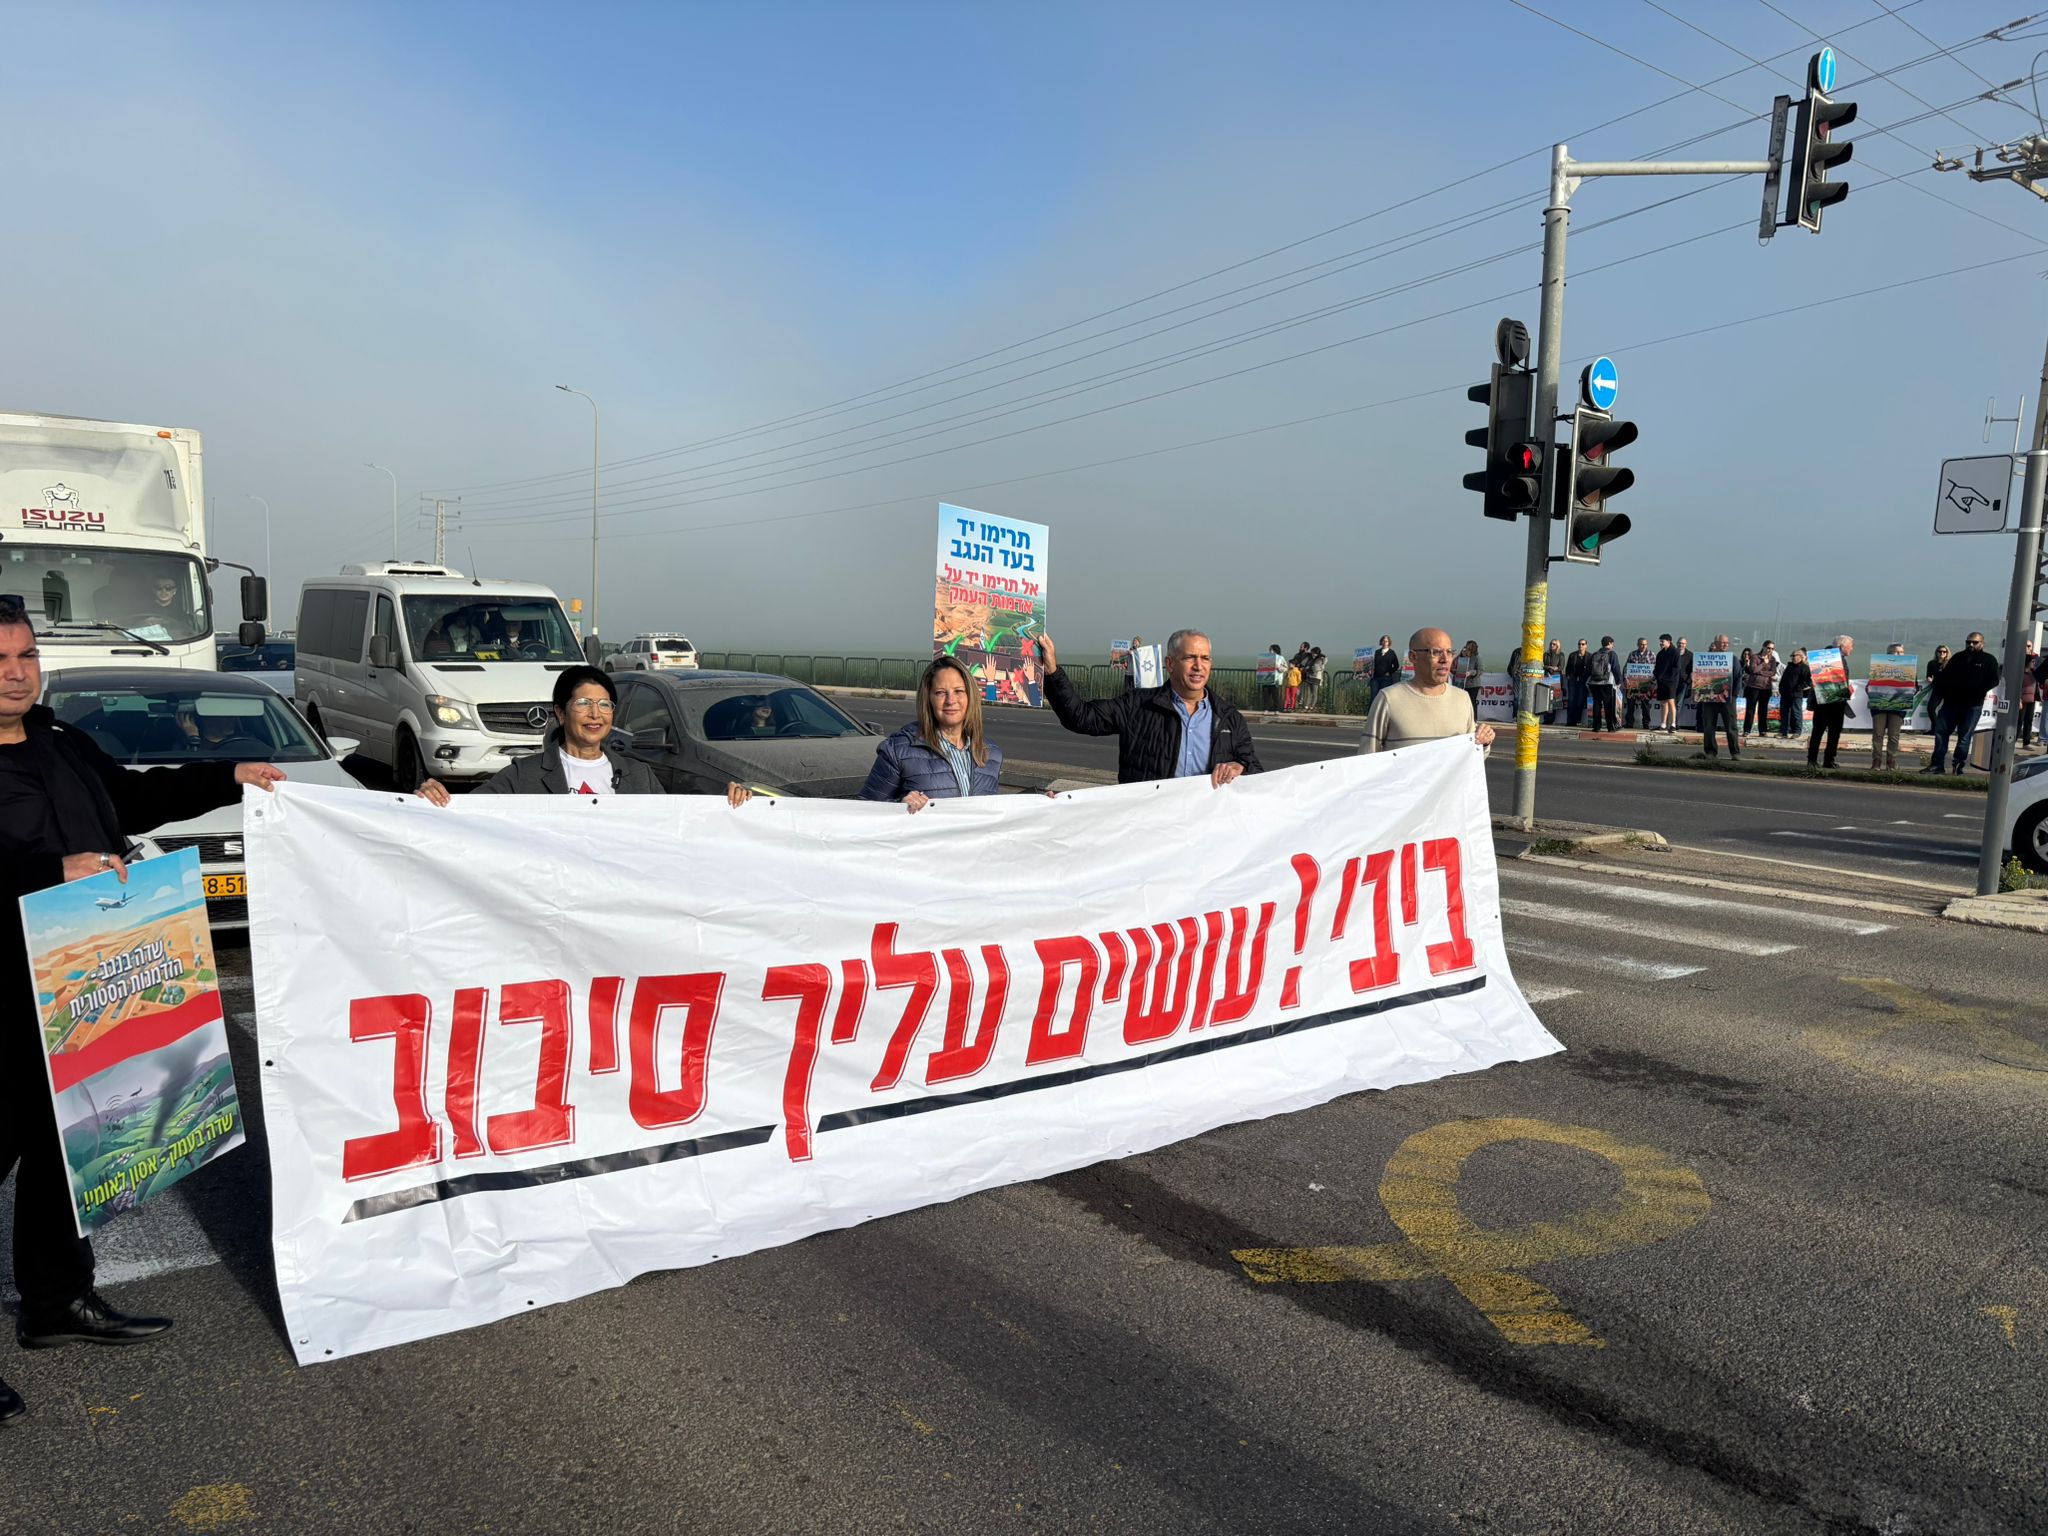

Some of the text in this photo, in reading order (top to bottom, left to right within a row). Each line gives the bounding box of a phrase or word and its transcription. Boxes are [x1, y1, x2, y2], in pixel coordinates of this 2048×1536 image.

[22, 508, 104, 523] ISUZU
[23, 520, 105, 532] SUMO
[957, 518, 1030, 549] תרימו יד
[950, 539, 1035, 572] בעד הנגב
[945, 563, 1039, 596] אל תרימו יד על
[949, 586, 1033, 613] אדמות העמק
[99, 953, 133, 980] בנגב
[134, 940, 164, 966] שדה
[69, 958, 185, 1019] הזדמנות הסטורית
[342, 837, 1477, 1183] ביבי! עושים עליך סיבוב
[205, 1113, 234, 1142] שדה
[168, 1129, 206, 1168] בעמק
[129, 1154, 158, 1192] אסון
[83, 1171, 127, 1212] לאומי!
